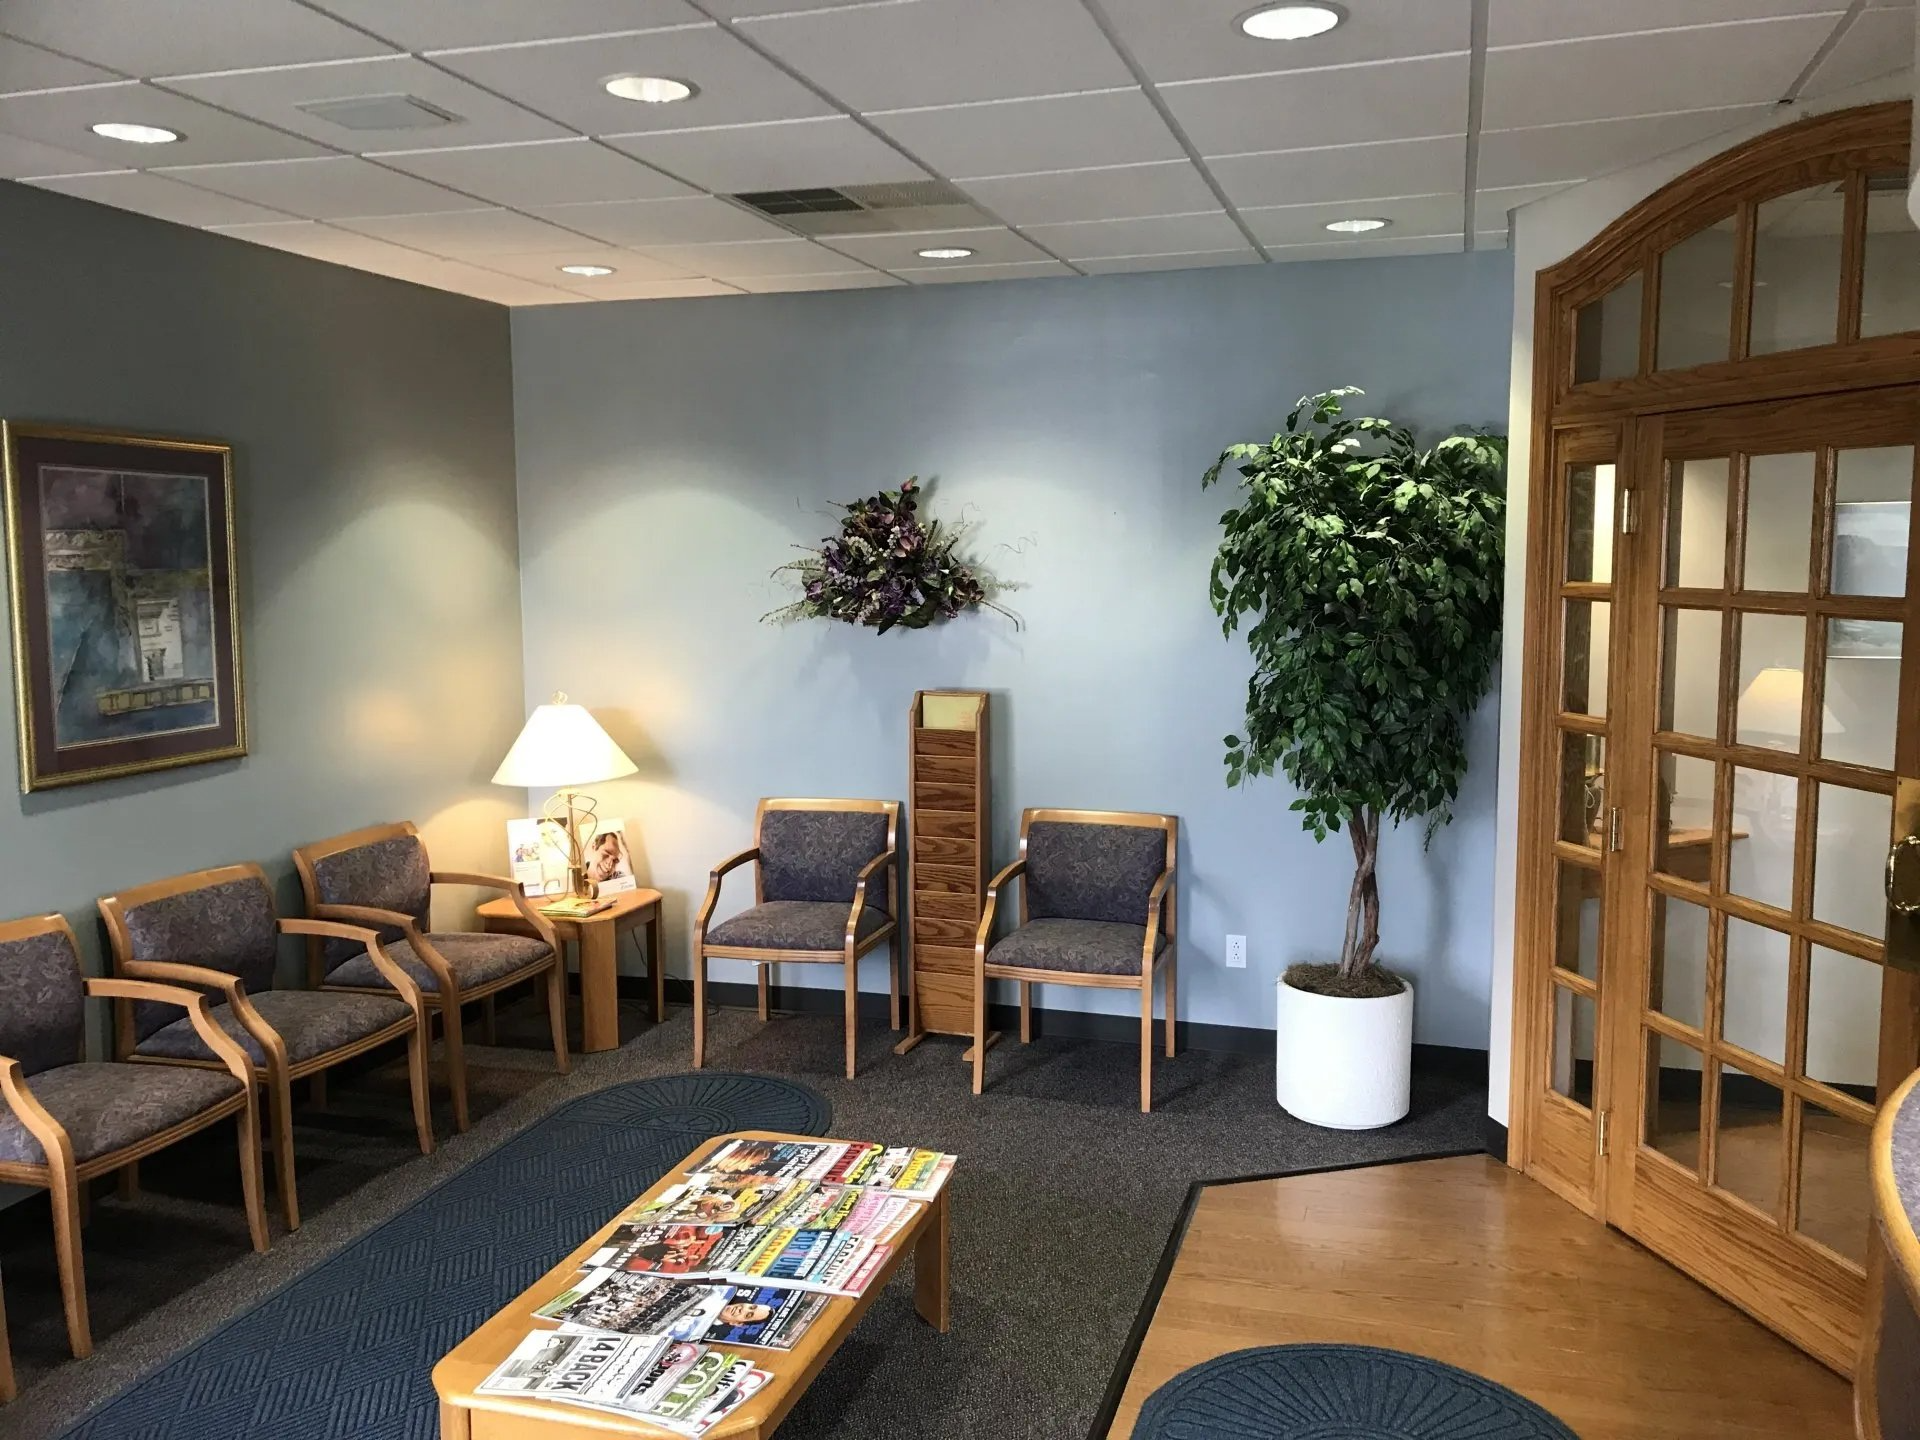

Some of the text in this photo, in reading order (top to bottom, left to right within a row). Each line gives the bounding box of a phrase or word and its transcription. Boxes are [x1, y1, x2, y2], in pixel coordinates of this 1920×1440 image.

[608, 1231, 653, 1268] COMPANY
[642, 1224, 668, 1246] FAST
[738, 1224, 766, 1246] Better
[746, 1228, 793, 1273] FORTUNE
[767, 1229, 820, 1278] FORTUNE
[757, 1289, 804, 1345] WHERE ARE THEY NOW?
[587, 1334, 623, 1354] 14
[549, 1351, 608, 1393] BACK
[649, 1350, 729, 1417] GOLF
[715, 1360, 749, 1388] Golf
